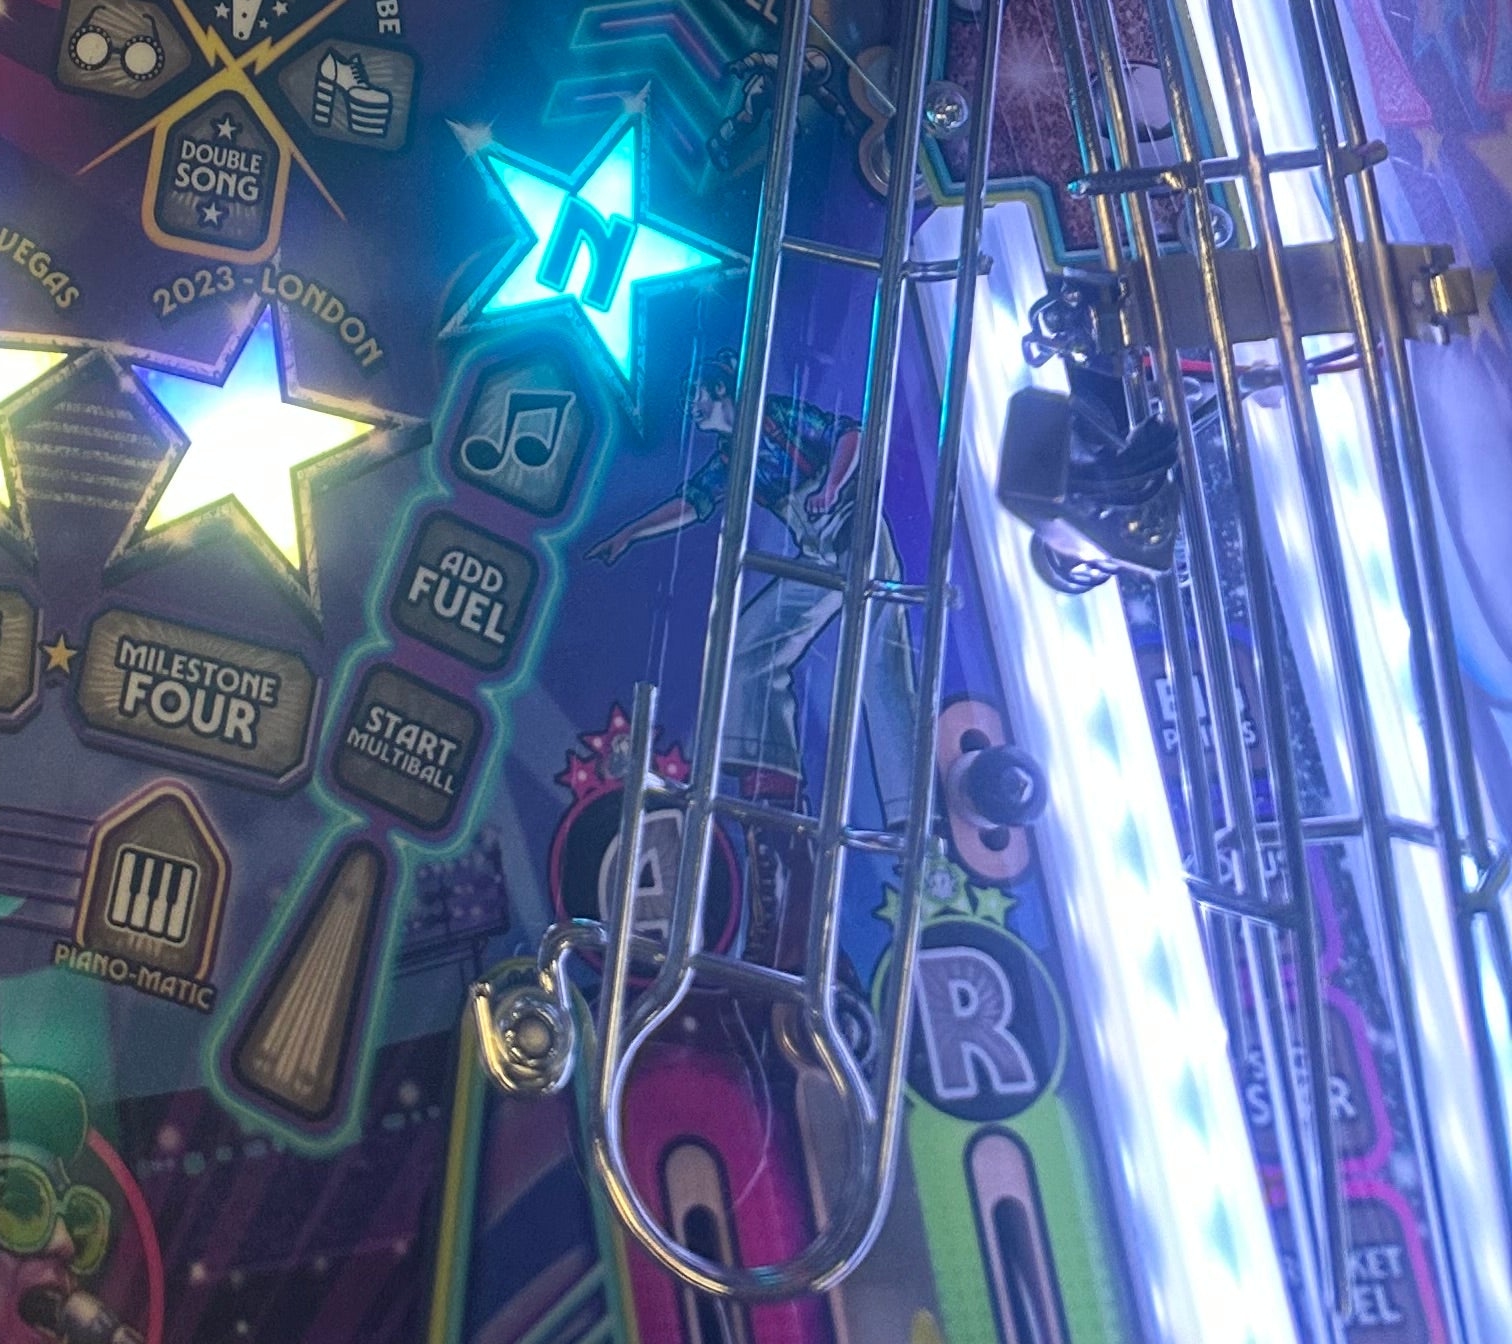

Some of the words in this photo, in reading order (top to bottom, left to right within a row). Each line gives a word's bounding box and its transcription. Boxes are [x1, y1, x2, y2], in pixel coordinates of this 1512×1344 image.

[174, 163, 259, 203] SONG
[180, 139, 264, 176] DOUBLE
[153, 265, 237, 318] 2023
[261, 268, 385, 367] LONDON
[408, 567, 506, 646] FUEL
[441, 550, 505, 593] ADD
[118, 640, 278, 704] MILESTONE
[121, 673, 257, 745] FOUR
[366, 705, 458, 766] START
[346, 726, 457, 796] MULTIBALL
[53, 942, 214, 1012] PIANO-MATIC
[913, 946, 1036, 1101] R
